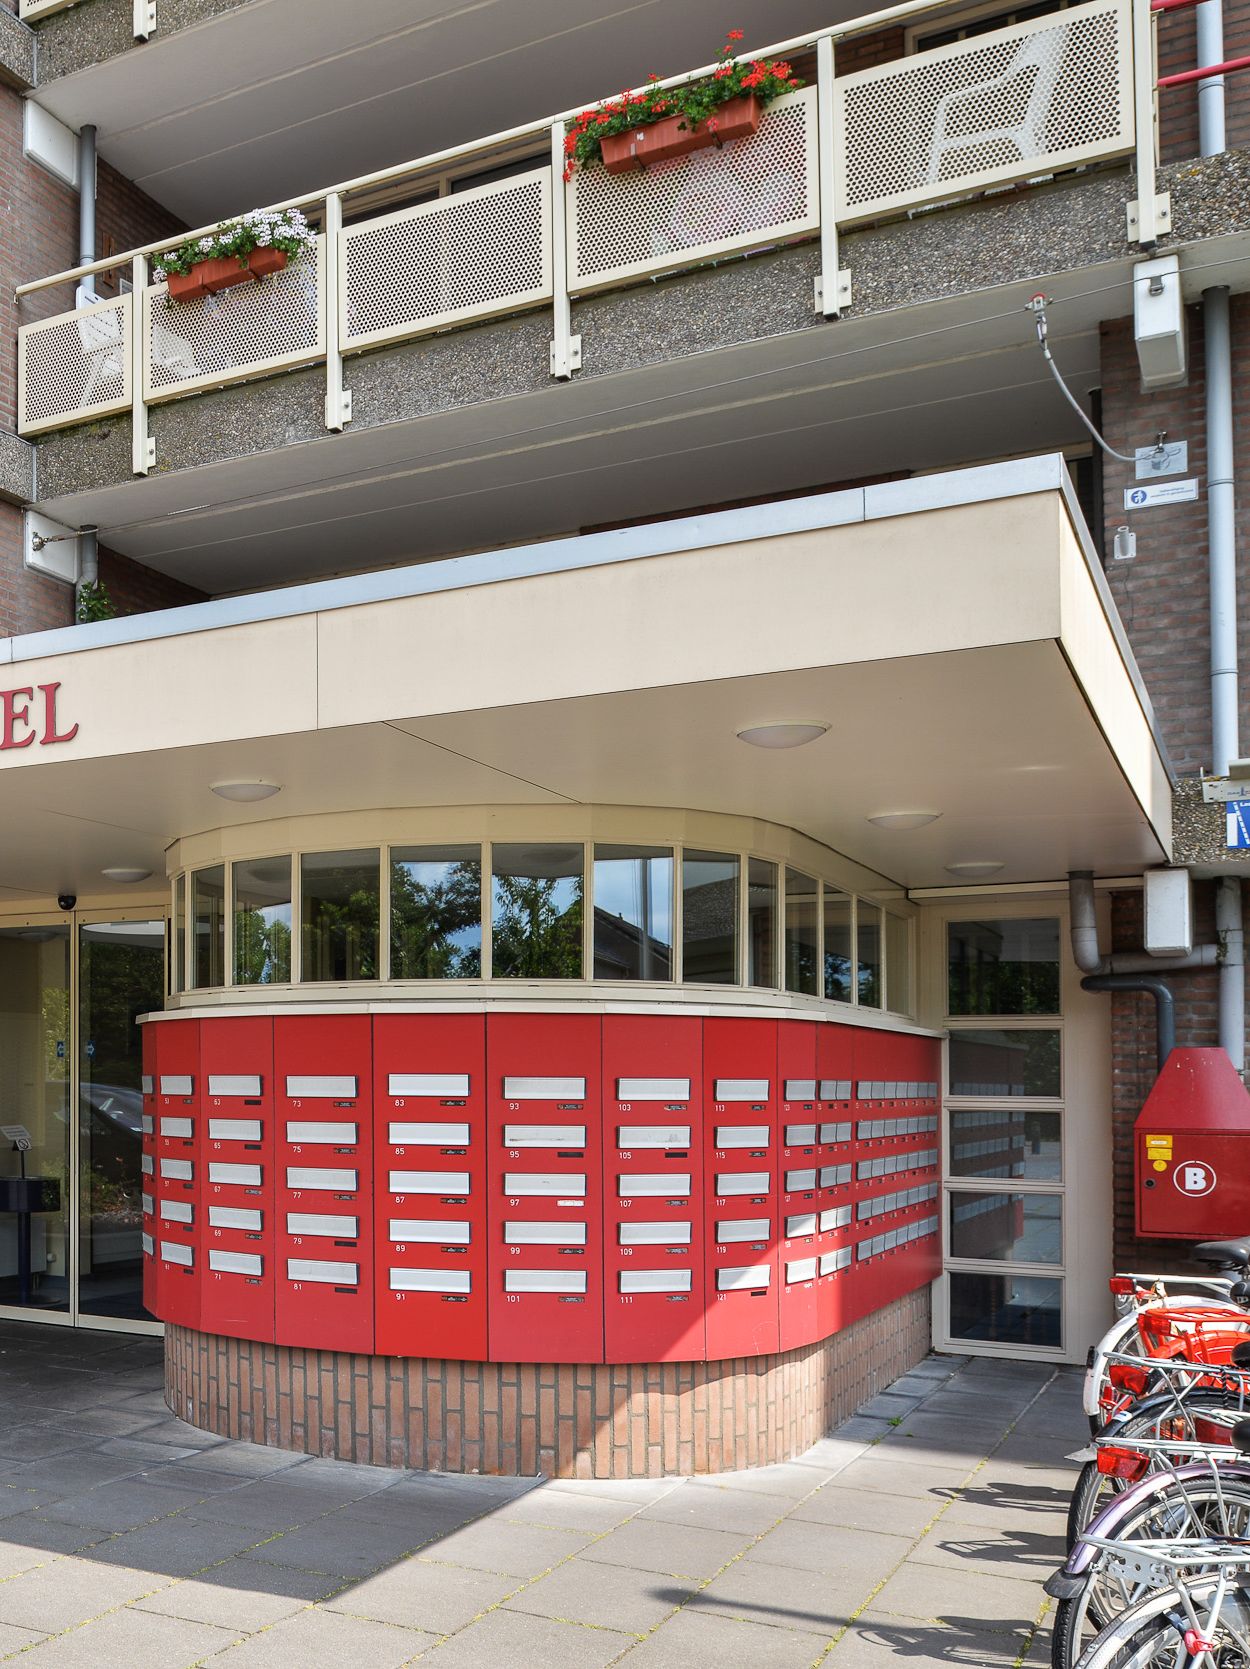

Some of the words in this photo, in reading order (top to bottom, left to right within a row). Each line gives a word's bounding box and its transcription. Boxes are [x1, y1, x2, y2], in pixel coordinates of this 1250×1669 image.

[292, 1100, 302, 1108] 73
[394, 1099, 405, 1107] 83
[509, 1102, 520, 1110] 93
[618, 1103, 632, 1112] 103
[715, 1104, 725, 1112] 113
[292, 1145, 302, 1153] 75
[395, 1147, 405, 1155] 85
[509, 1150, 520, 1158] 95
[619, 1151, 632, 1160] 105
[715, 1151, 726, 1159] 115
[1185, 1167, 1206, 1190] B
[293, 1191, 302, 1199] 77
[395, 1195, 405, 1204] 87
[509, 1198, 520, 1207] 97
[619, 1199, 632, 1208] 107
[716, 1198, 726, 1206] 117
[293, 1237, 302, 1245] 79
[395, 1244, 406, 1252] 89
[510, 1246, 521, 1255] 99
[620, 1247, 633, 1256] 109
[716, 1245, 727, 1254] 119
[293, 1283, 302, 1291] 81
[395, 1292, 406, 1301] 91
[506, 1295, 520, 1303] 101
[620, 1296, 633, 1304] 111
[717, 1293, 727, 1301] 121
